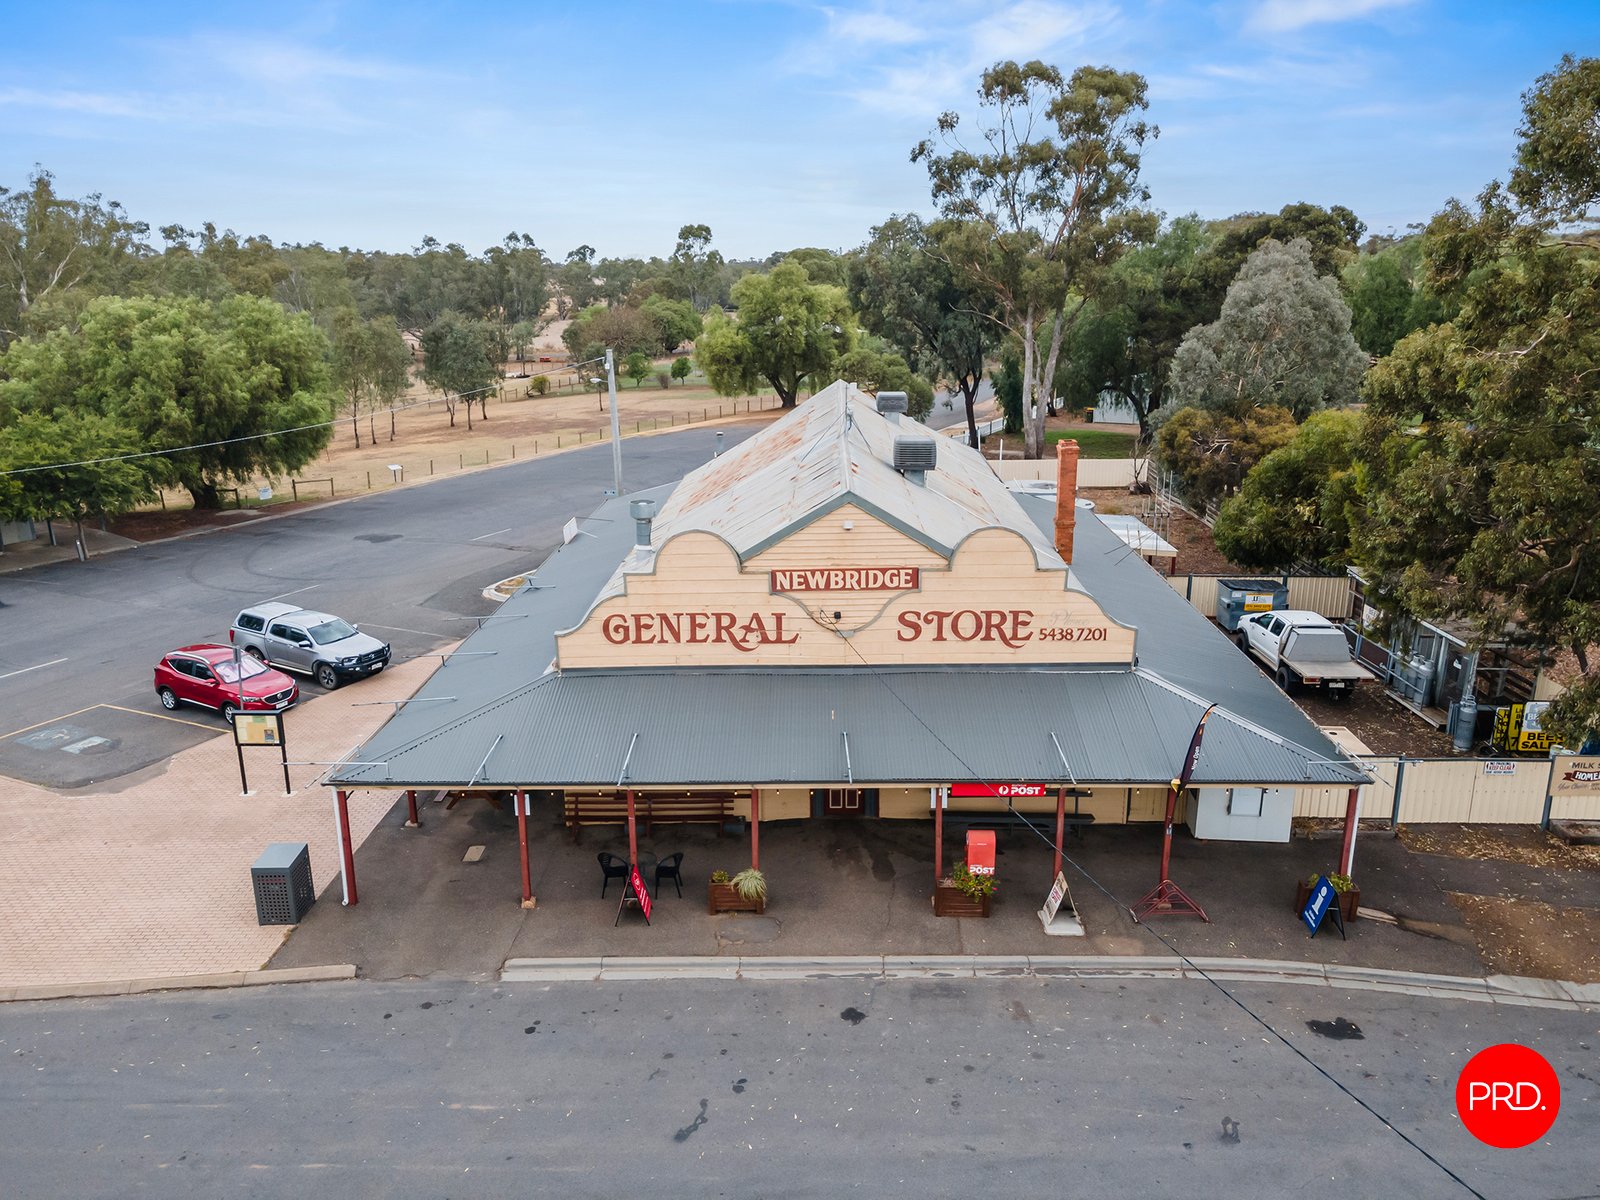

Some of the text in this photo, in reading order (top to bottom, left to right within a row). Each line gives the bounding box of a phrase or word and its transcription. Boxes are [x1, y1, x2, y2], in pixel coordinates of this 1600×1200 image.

[775, 569, 913, 590] NEWBRIDGE
[602, 612, 799, 652] GENERAL
[897, 610, 1034, 649] STORE
[1010, 786, 1041, 795] POST
[969, 866, 995, 875] POST
